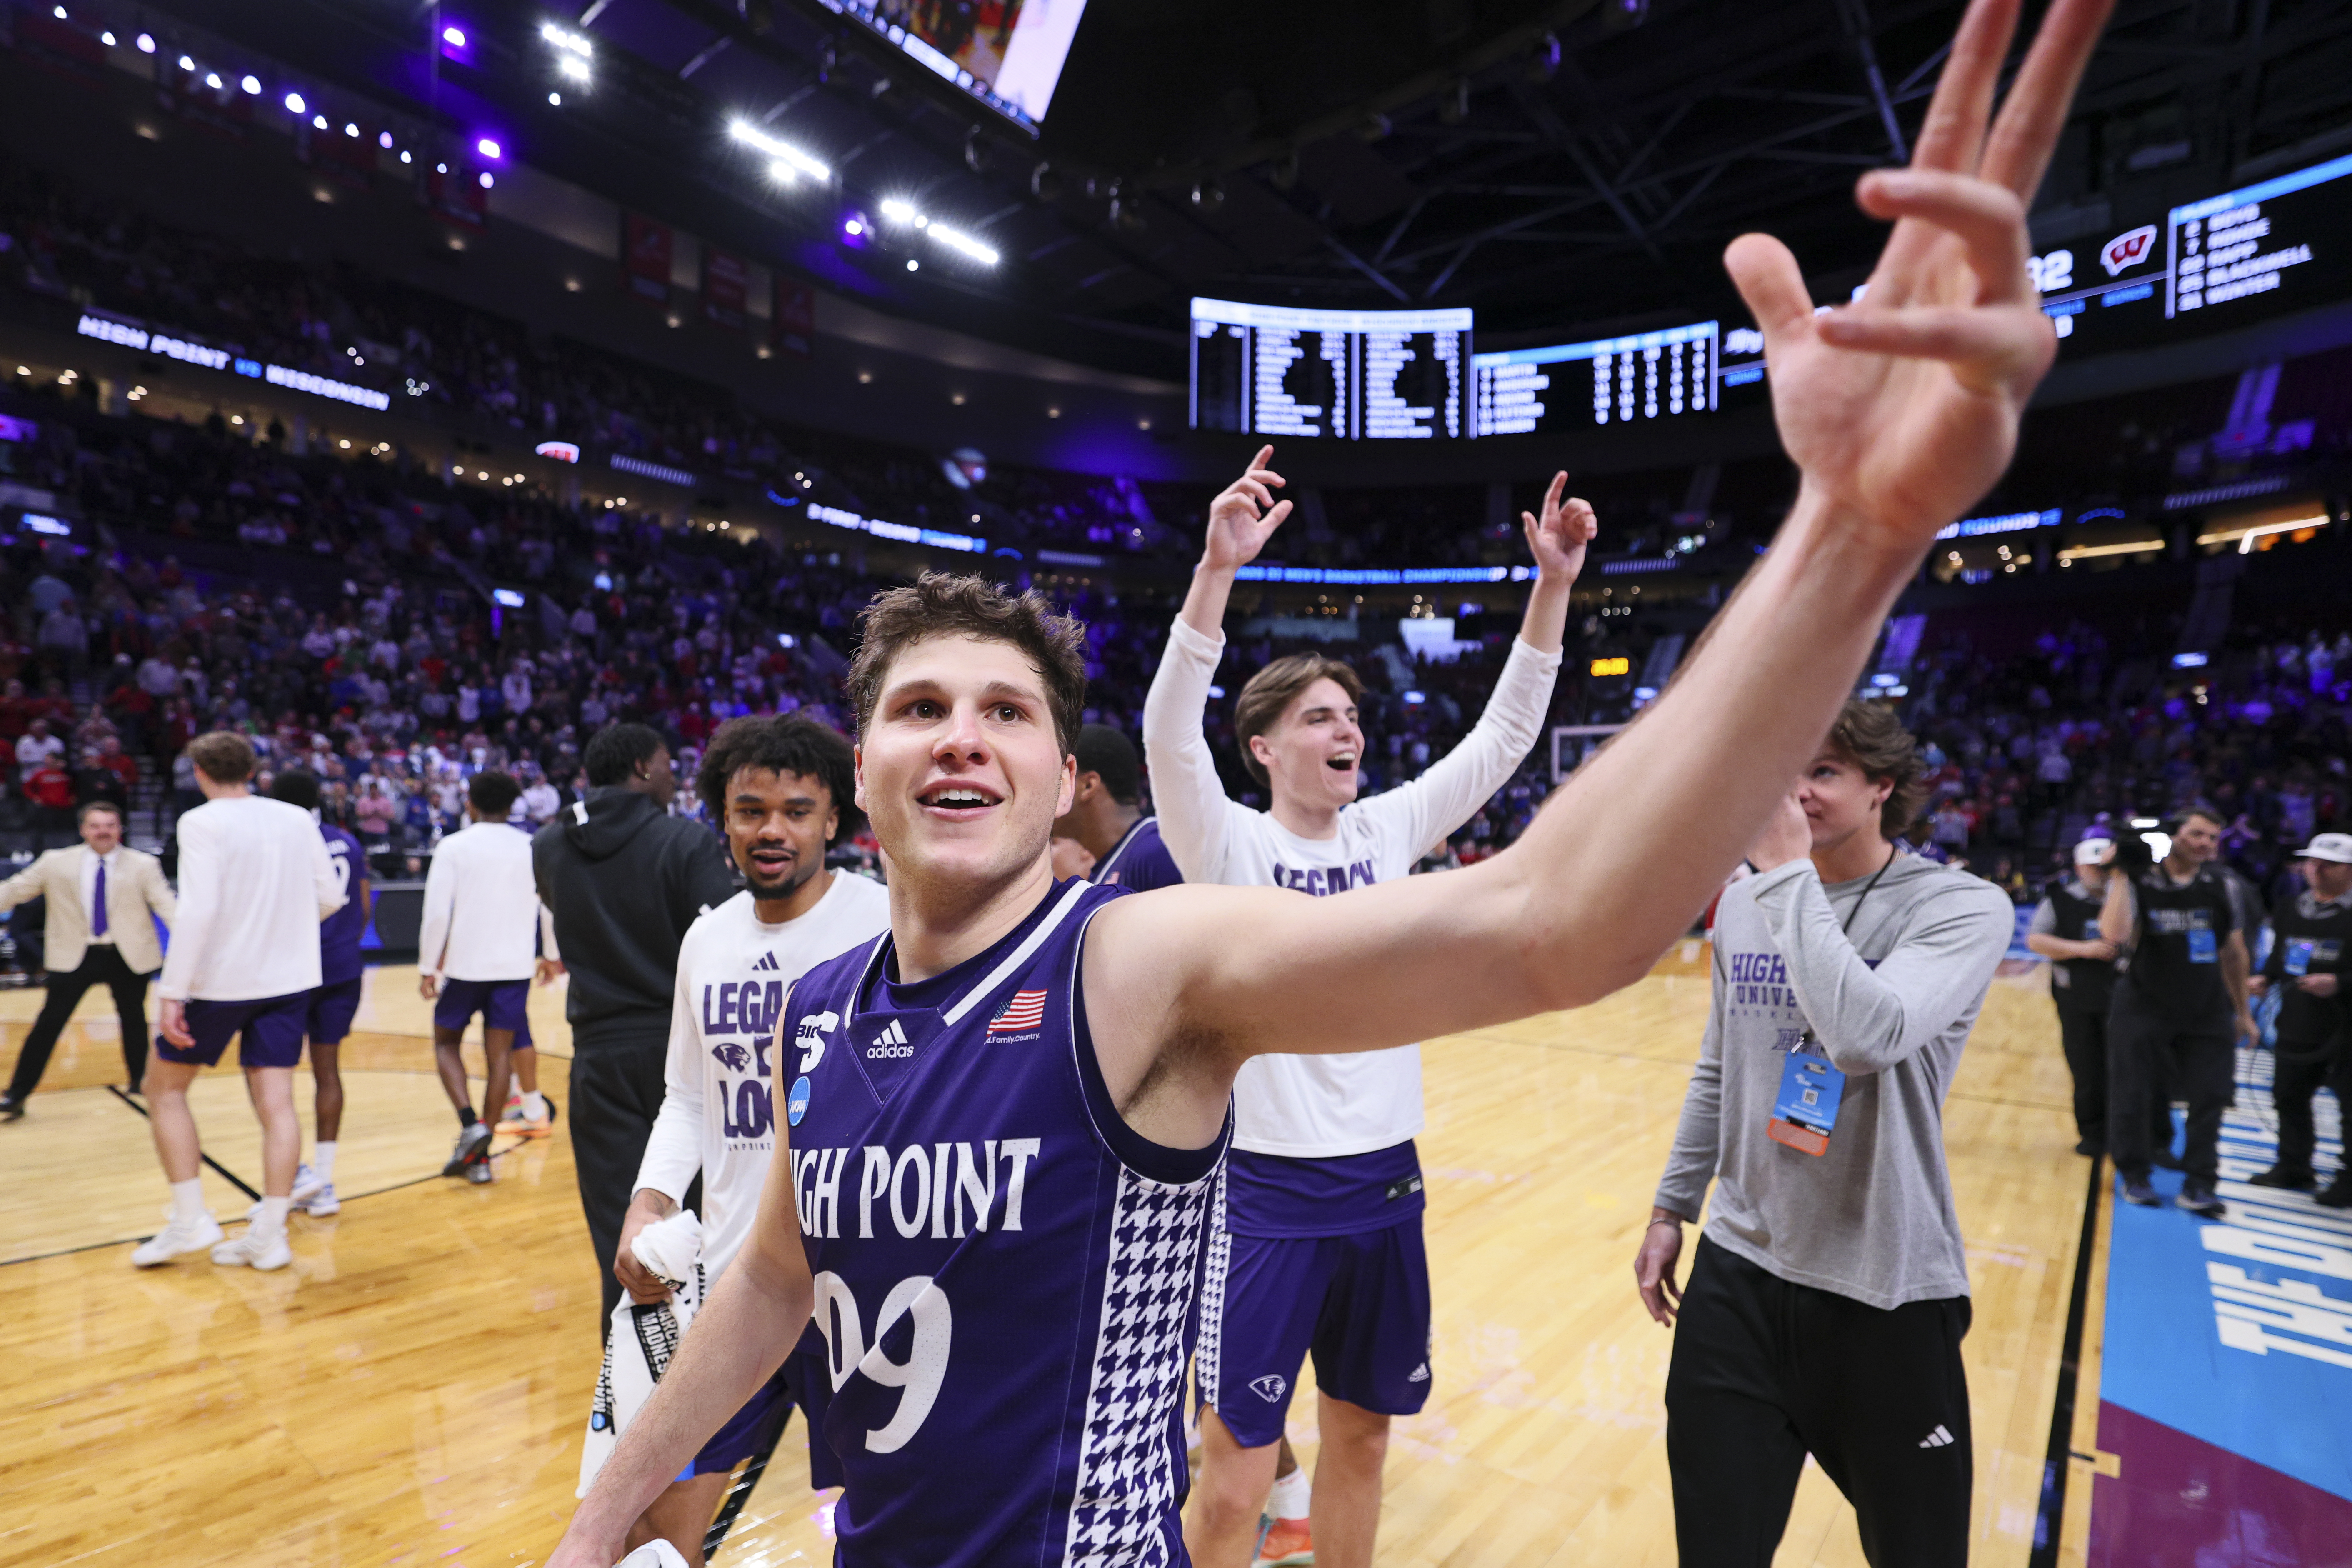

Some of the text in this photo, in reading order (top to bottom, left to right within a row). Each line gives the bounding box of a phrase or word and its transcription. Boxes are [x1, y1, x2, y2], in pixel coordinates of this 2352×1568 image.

[1731, 953, 1787, 984] HIGH
[703, 979, 799, 1035] LEGA
[867, 1043, 914, 1059] adidas
[719, 1080, 775, 1139] LO
[790, 1100, 807, 1113] NCAA
[789, 1138, 1041, 1238] IGH POINT
